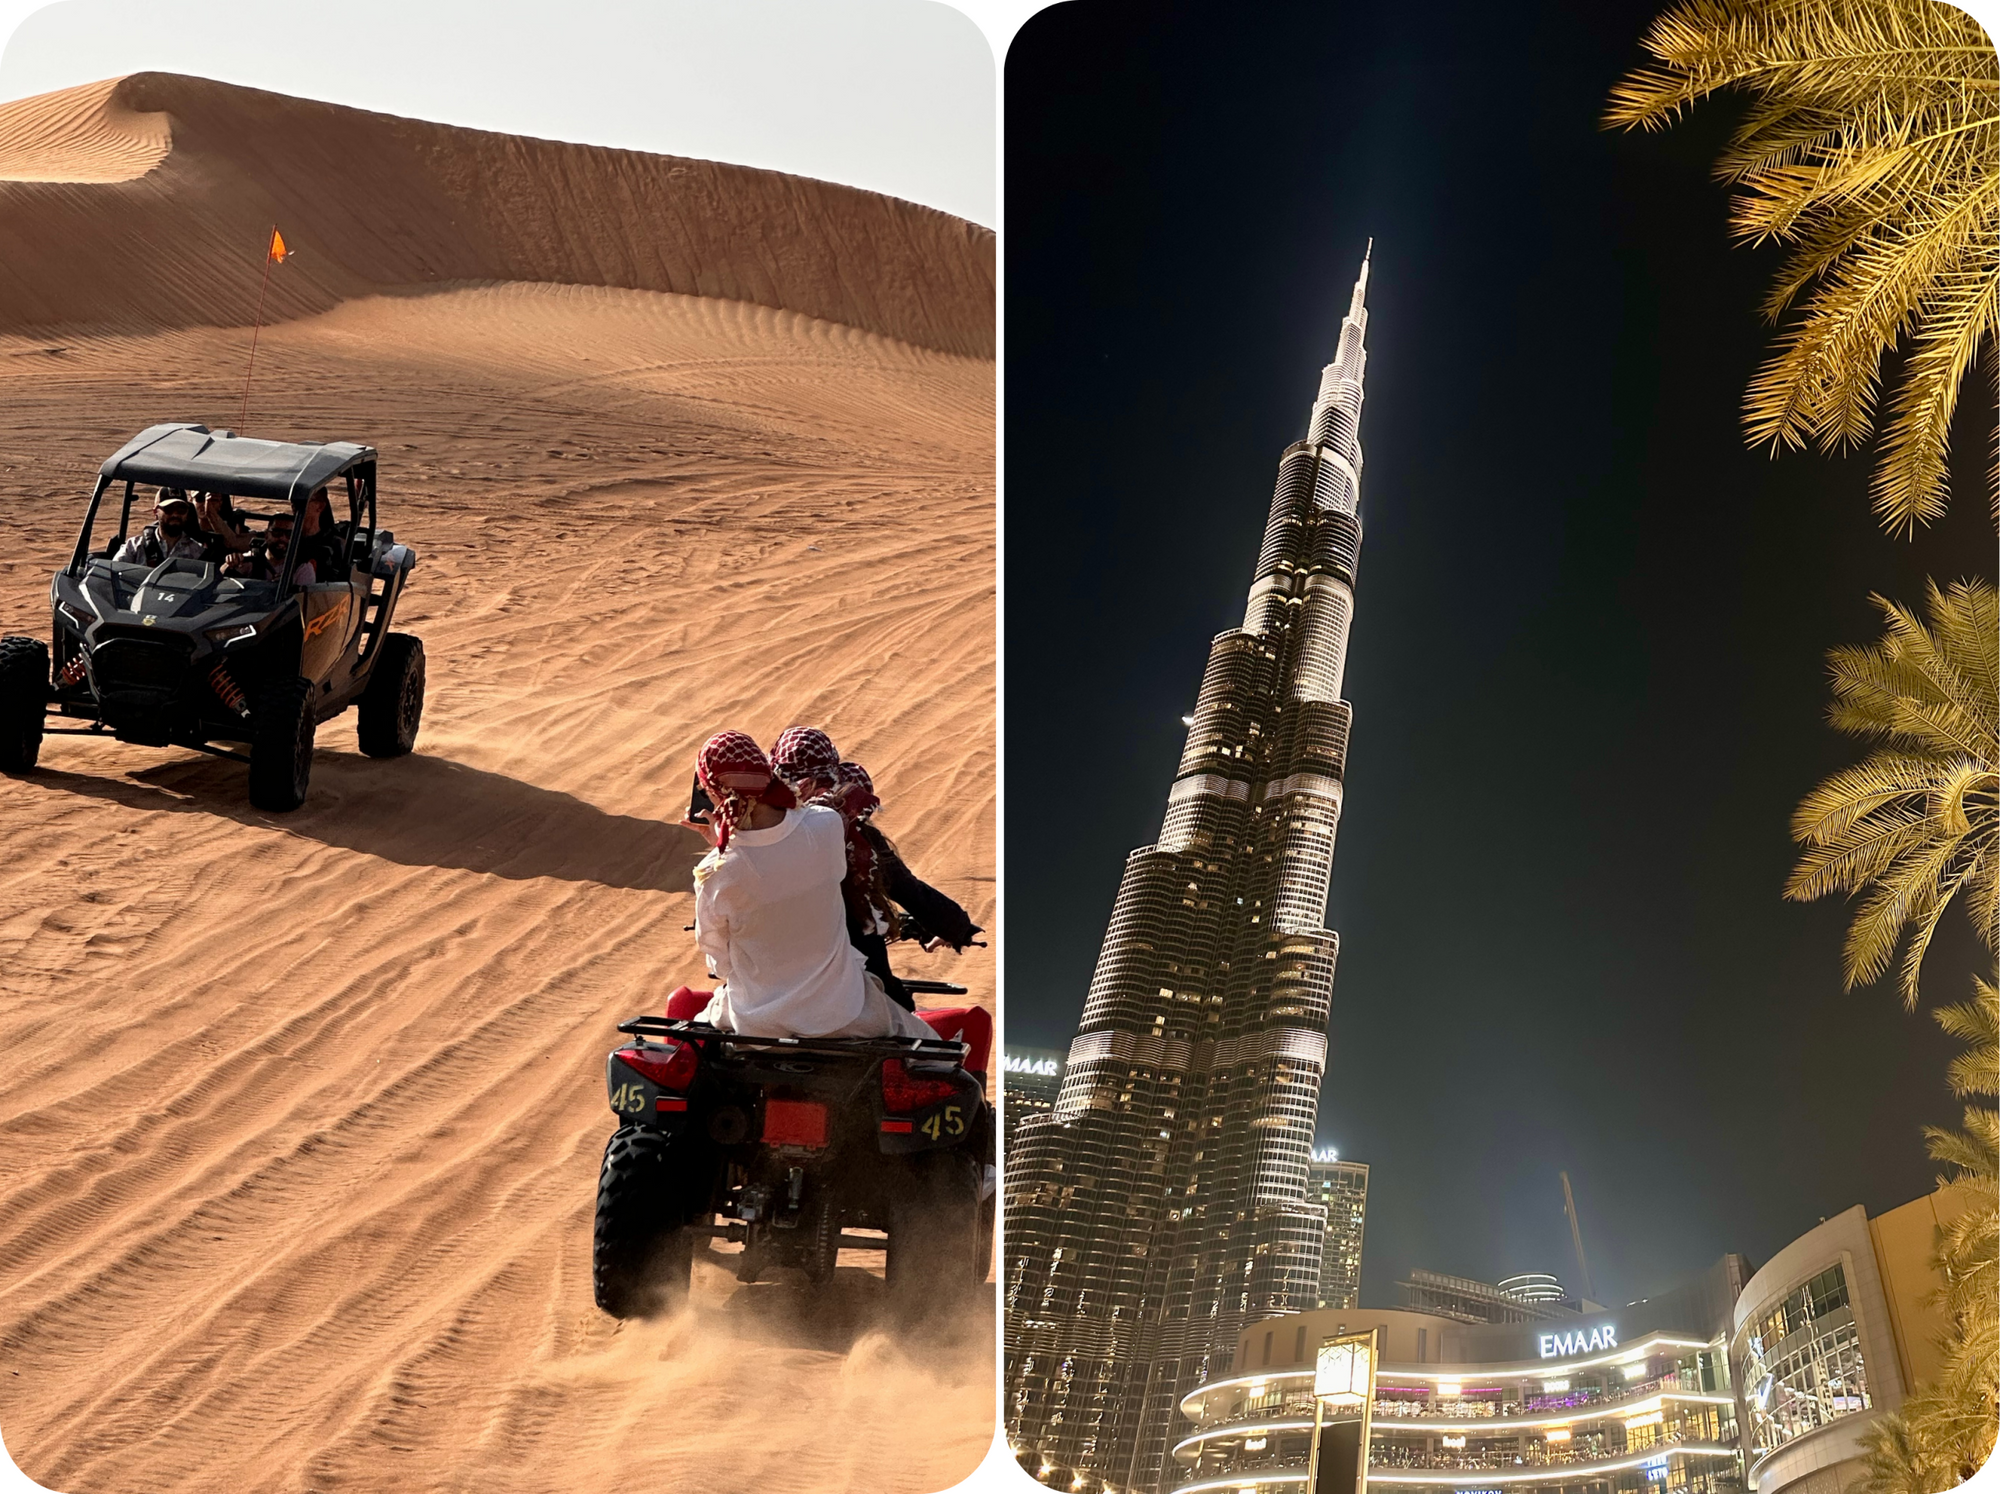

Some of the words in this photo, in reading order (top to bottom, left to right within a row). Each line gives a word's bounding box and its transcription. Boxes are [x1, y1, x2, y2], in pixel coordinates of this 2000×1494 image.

[157, 592, 175, 602] 14
[610, 1083, 645, 1113] 45
[921, 1105, 964, 1141] 45
[1540, 1325, 1618, 1358] EMAAR
